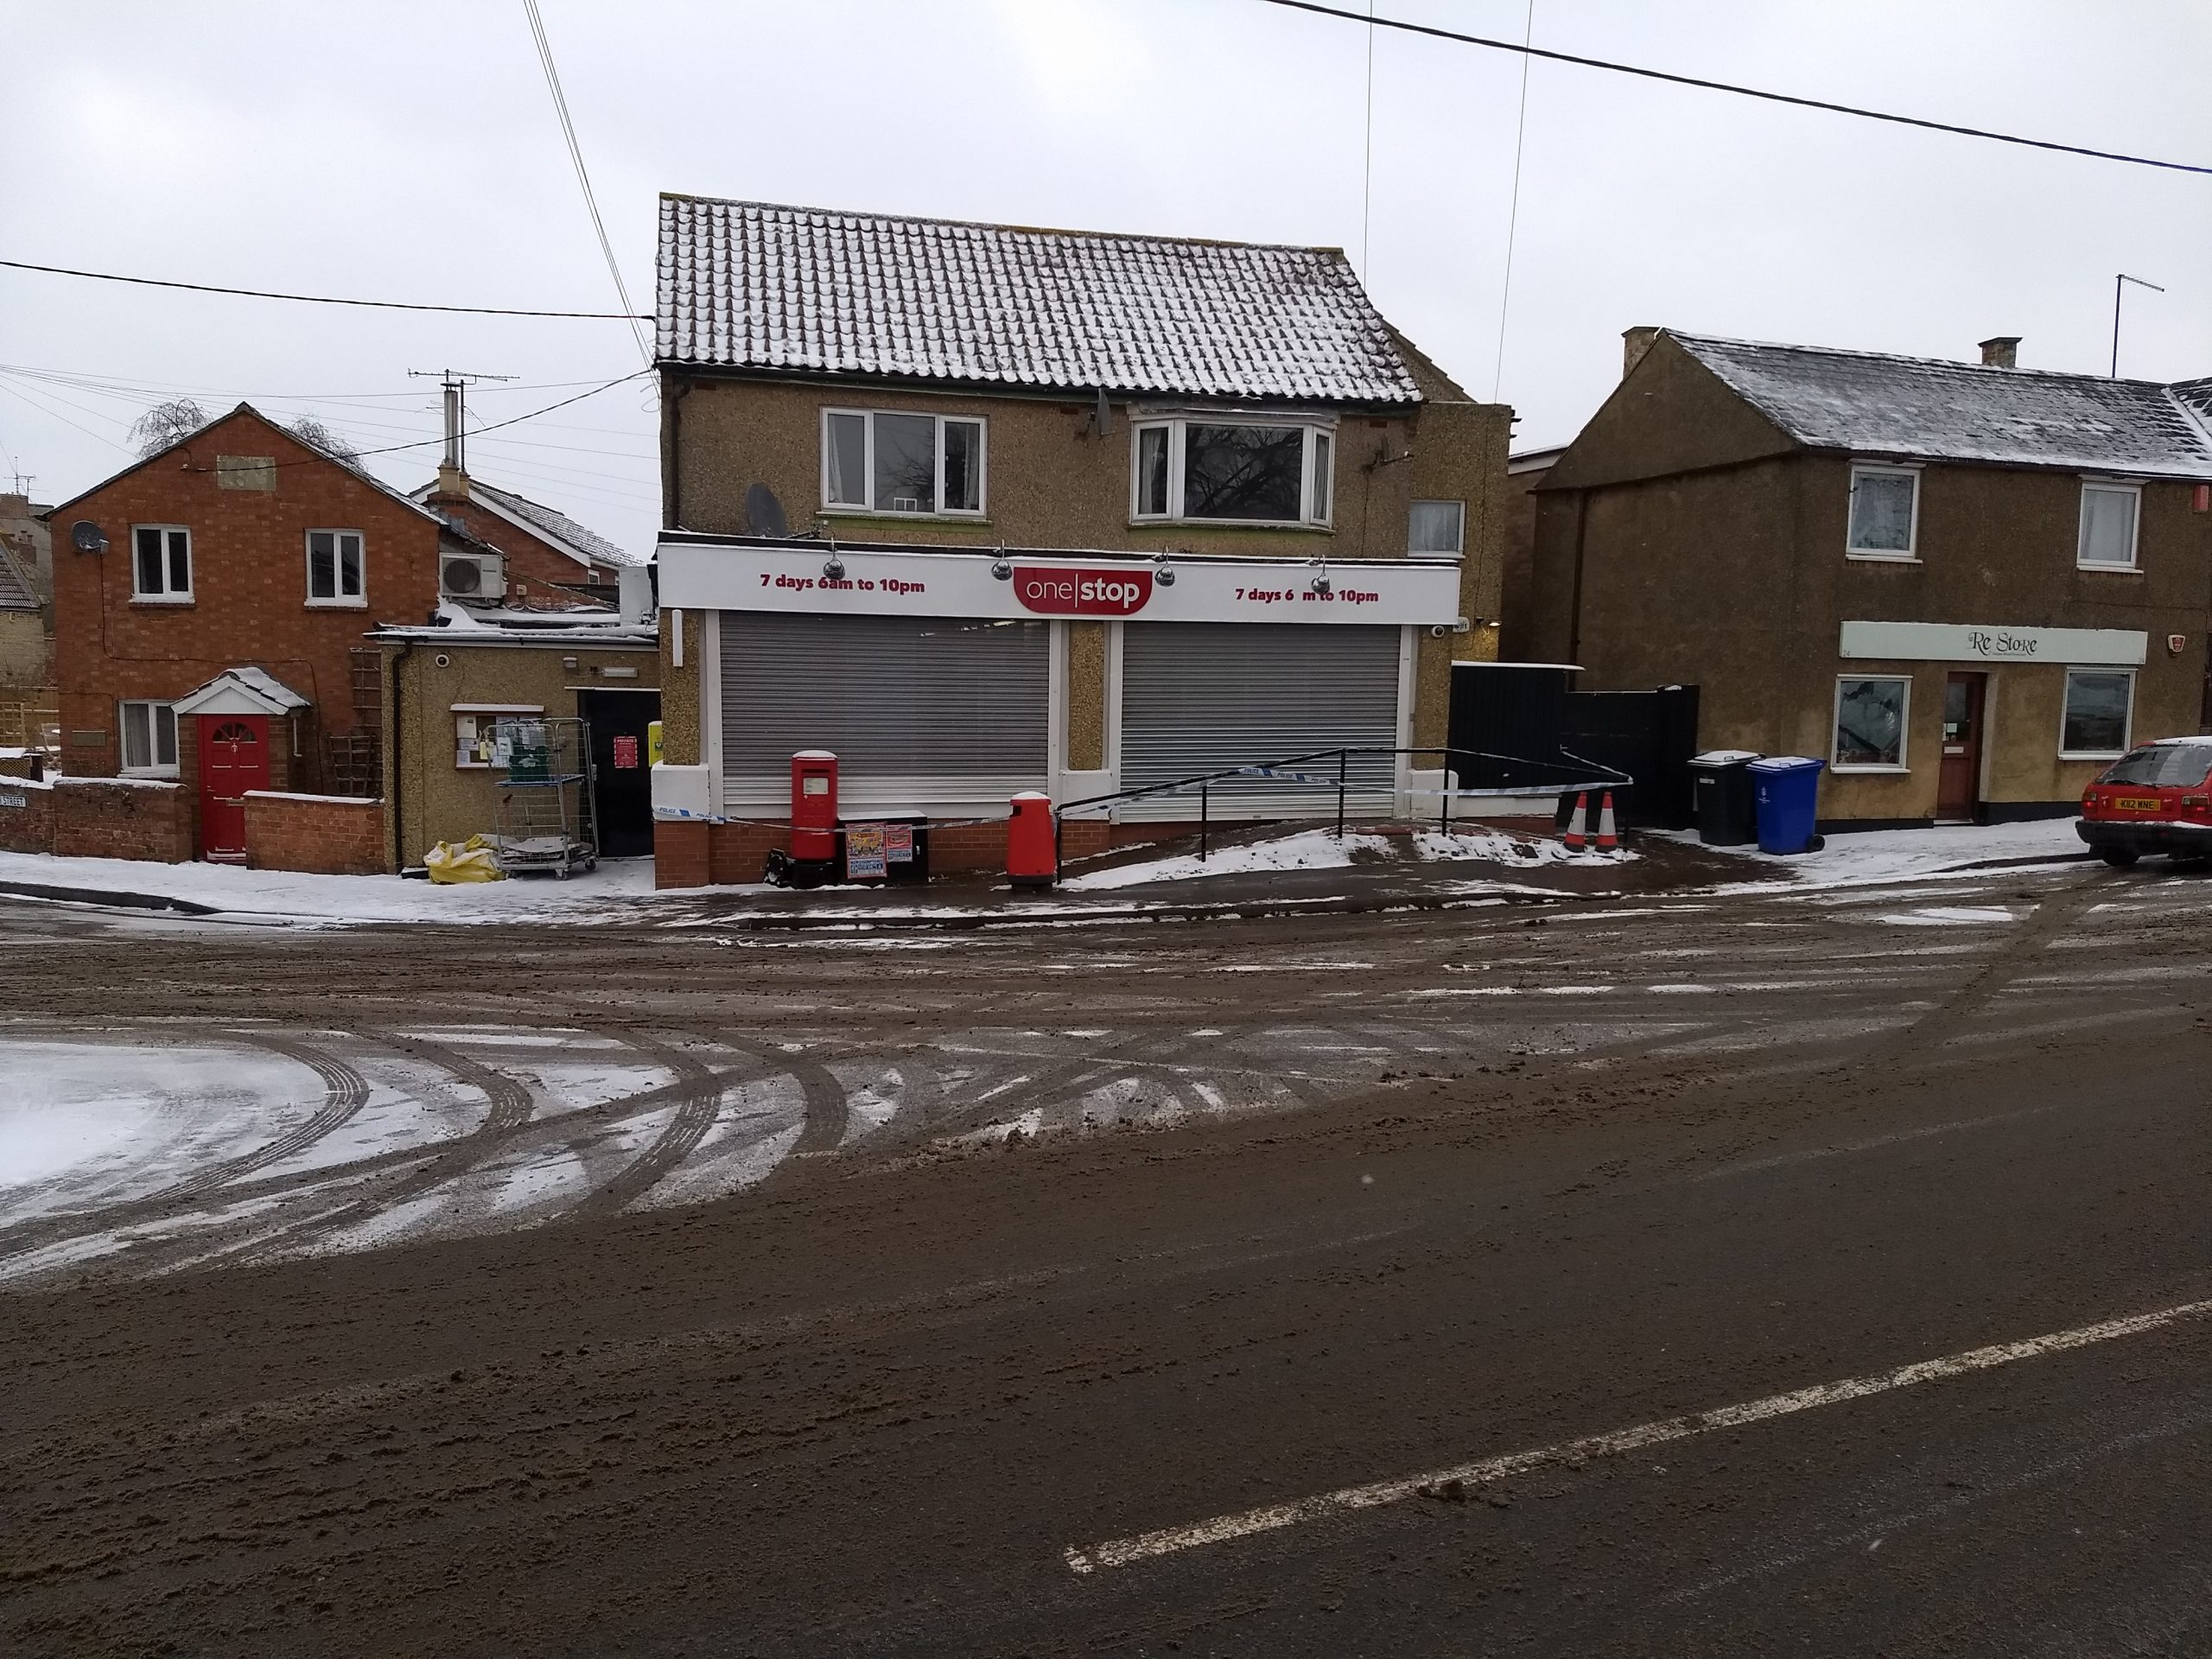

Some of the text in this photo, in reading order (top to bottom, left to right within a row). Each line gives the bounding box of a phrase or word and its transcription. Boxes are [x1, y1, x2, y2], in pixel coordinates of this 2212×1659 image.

[760, 574, 925, 595] 7 days 6am to 10pm
[1080, 577, 1140, 608] stop
[1236, 588, 1244, 601] 7
[1248, 588, 1281, 604] days
[1338, 590, 1378, 605] 10pm
[1968, 632, 1991, 656] Re
[3, 797, 22, 805] STREET
